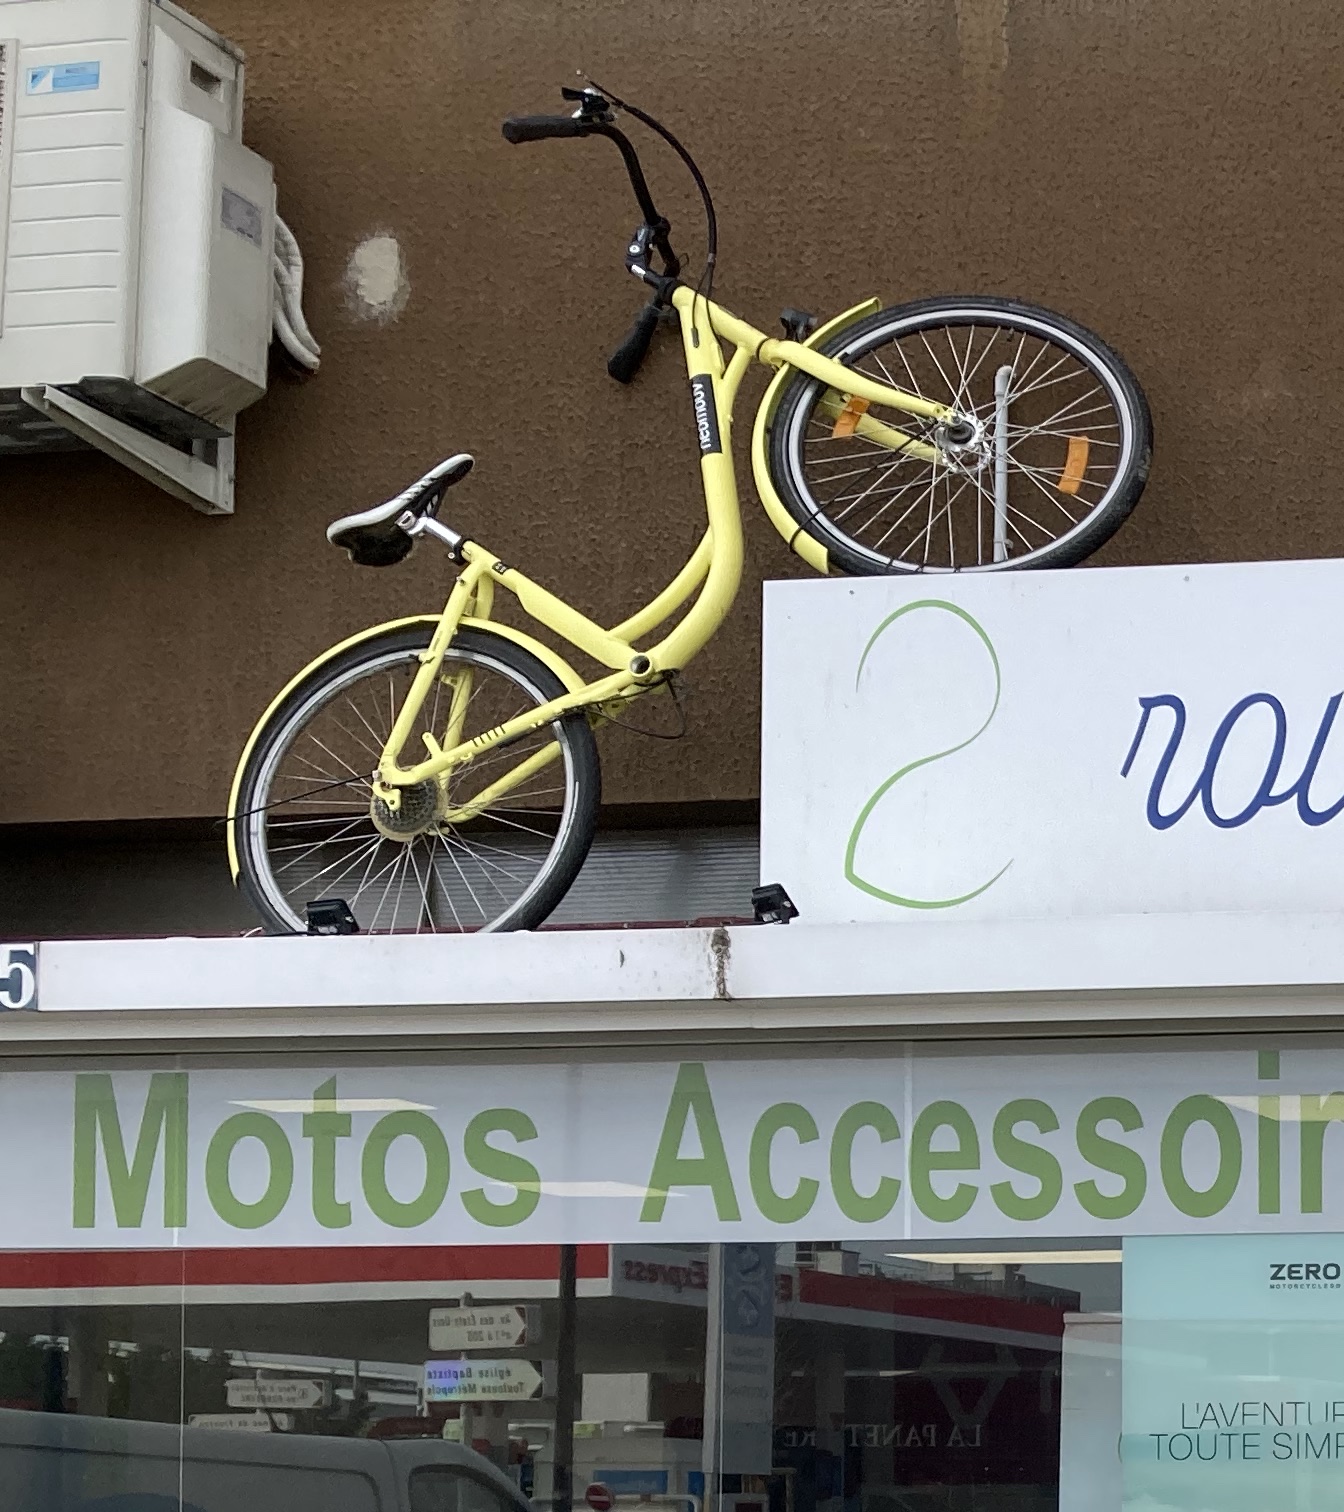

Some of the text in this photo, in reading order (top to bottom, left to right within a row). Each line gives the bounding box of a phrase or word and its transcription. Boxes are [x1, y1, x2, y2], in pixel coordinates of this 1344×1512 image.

[72, 1072, 542, 1232] Motos
[1269, 1263, 1340, 1281] ZERO
[1149, 1431, 1261, 1461] TOUTE
